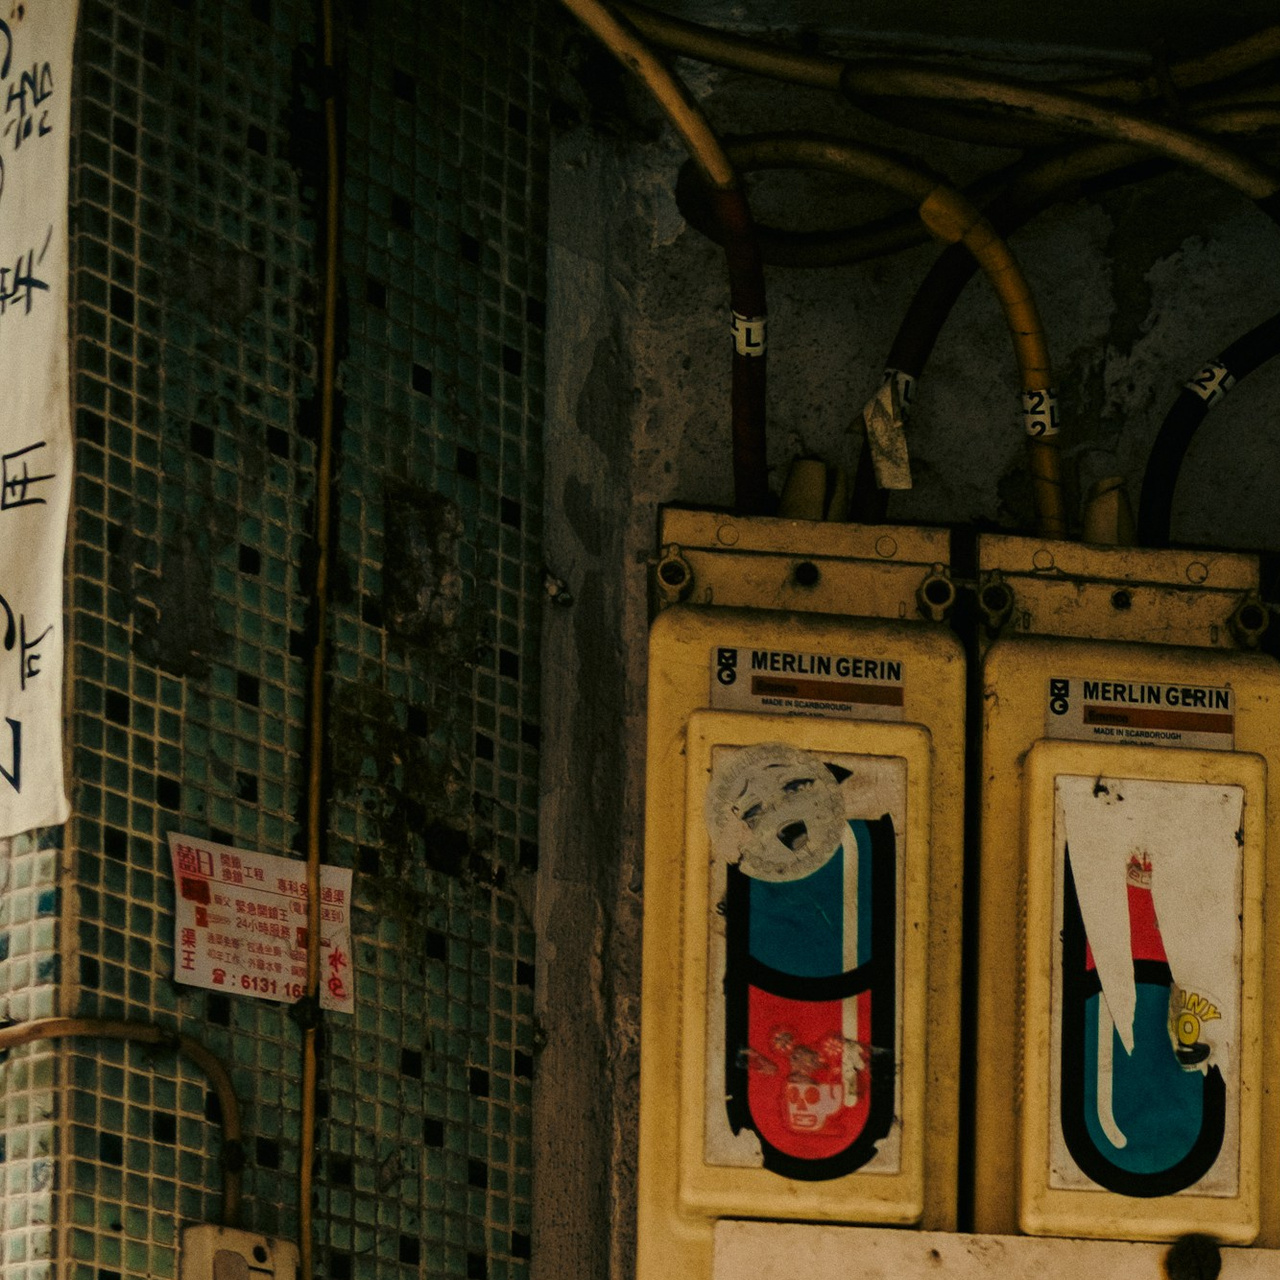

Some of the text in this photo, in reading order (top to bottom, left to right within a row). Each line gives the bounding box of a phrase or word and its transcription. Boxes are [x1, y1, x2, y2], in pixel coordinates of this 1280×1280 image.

[752, 651, 901, 680] MERLIN GERIN
[1084, 682, 1229, 709] MERLIN GERIN
[181, 928, 196, 970] 渠王
[241, 975, 277, 994] 6131
